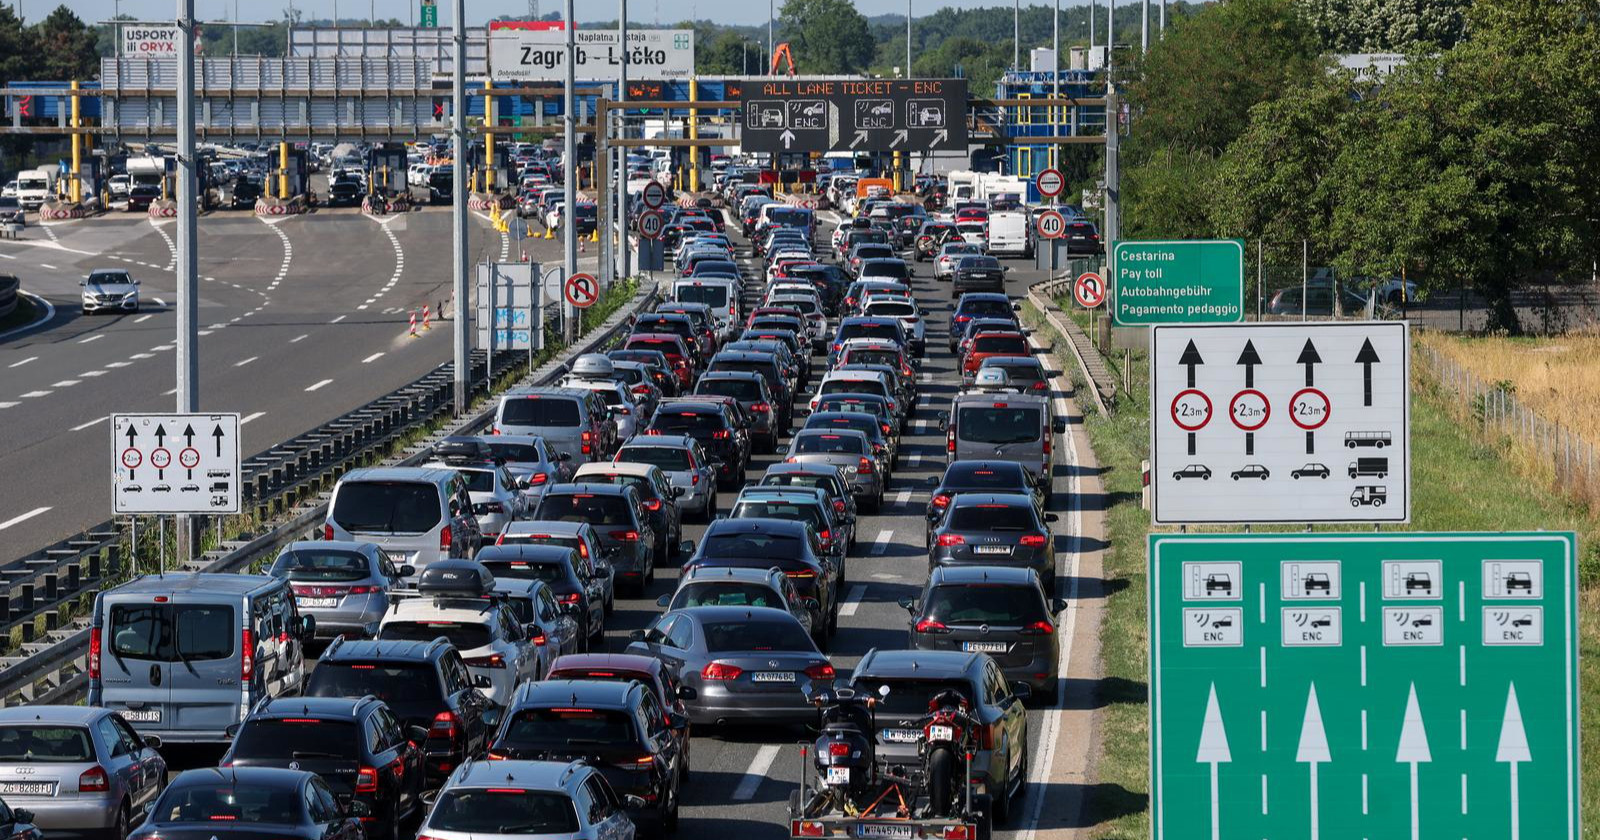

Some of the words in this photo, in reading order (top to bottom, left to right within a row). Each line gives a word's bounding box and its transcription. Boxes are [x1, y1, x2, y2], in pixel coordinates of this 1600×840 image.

[127, 30, 178, 40] USPORY
[578, 33, 613, 42] Naplatna
[127, 42, 136, 52] ili
[520, 46, 587, 69] Zagrb
[608, 45, 667, 65] Lčko
[763, 83, 791, 95] ALL
[797, 83, 834, 95] LANE
[841, 82, 893, 95] TICKET
[914, 81, 942, 94] ENC
[795, 118, 819, 128] ENC
[862, 117, 887, 128] ENC
[644, 218, 658, 232] 40
[1044, 218, 1059, 232] 40
[1121, 250, 1175, 261] Cestarina
[1121, 268, 1141, 280] Pay
[1145, 268, 1162, 279] toll
[1121, 286, 1212, 299] Autobahngebühr
[1121, 304, 1184, 317] Pagamento
[1188, 303, 1238, 316] pedaggio
[1204, 632, 1224, 641] ENC
[1302, 632, 1322, 641] ENC
[1403, 631, 1424, 640] ENC
[1503, 631, 1523, 640] ENC
[3, 783, 14, 793] ZG
